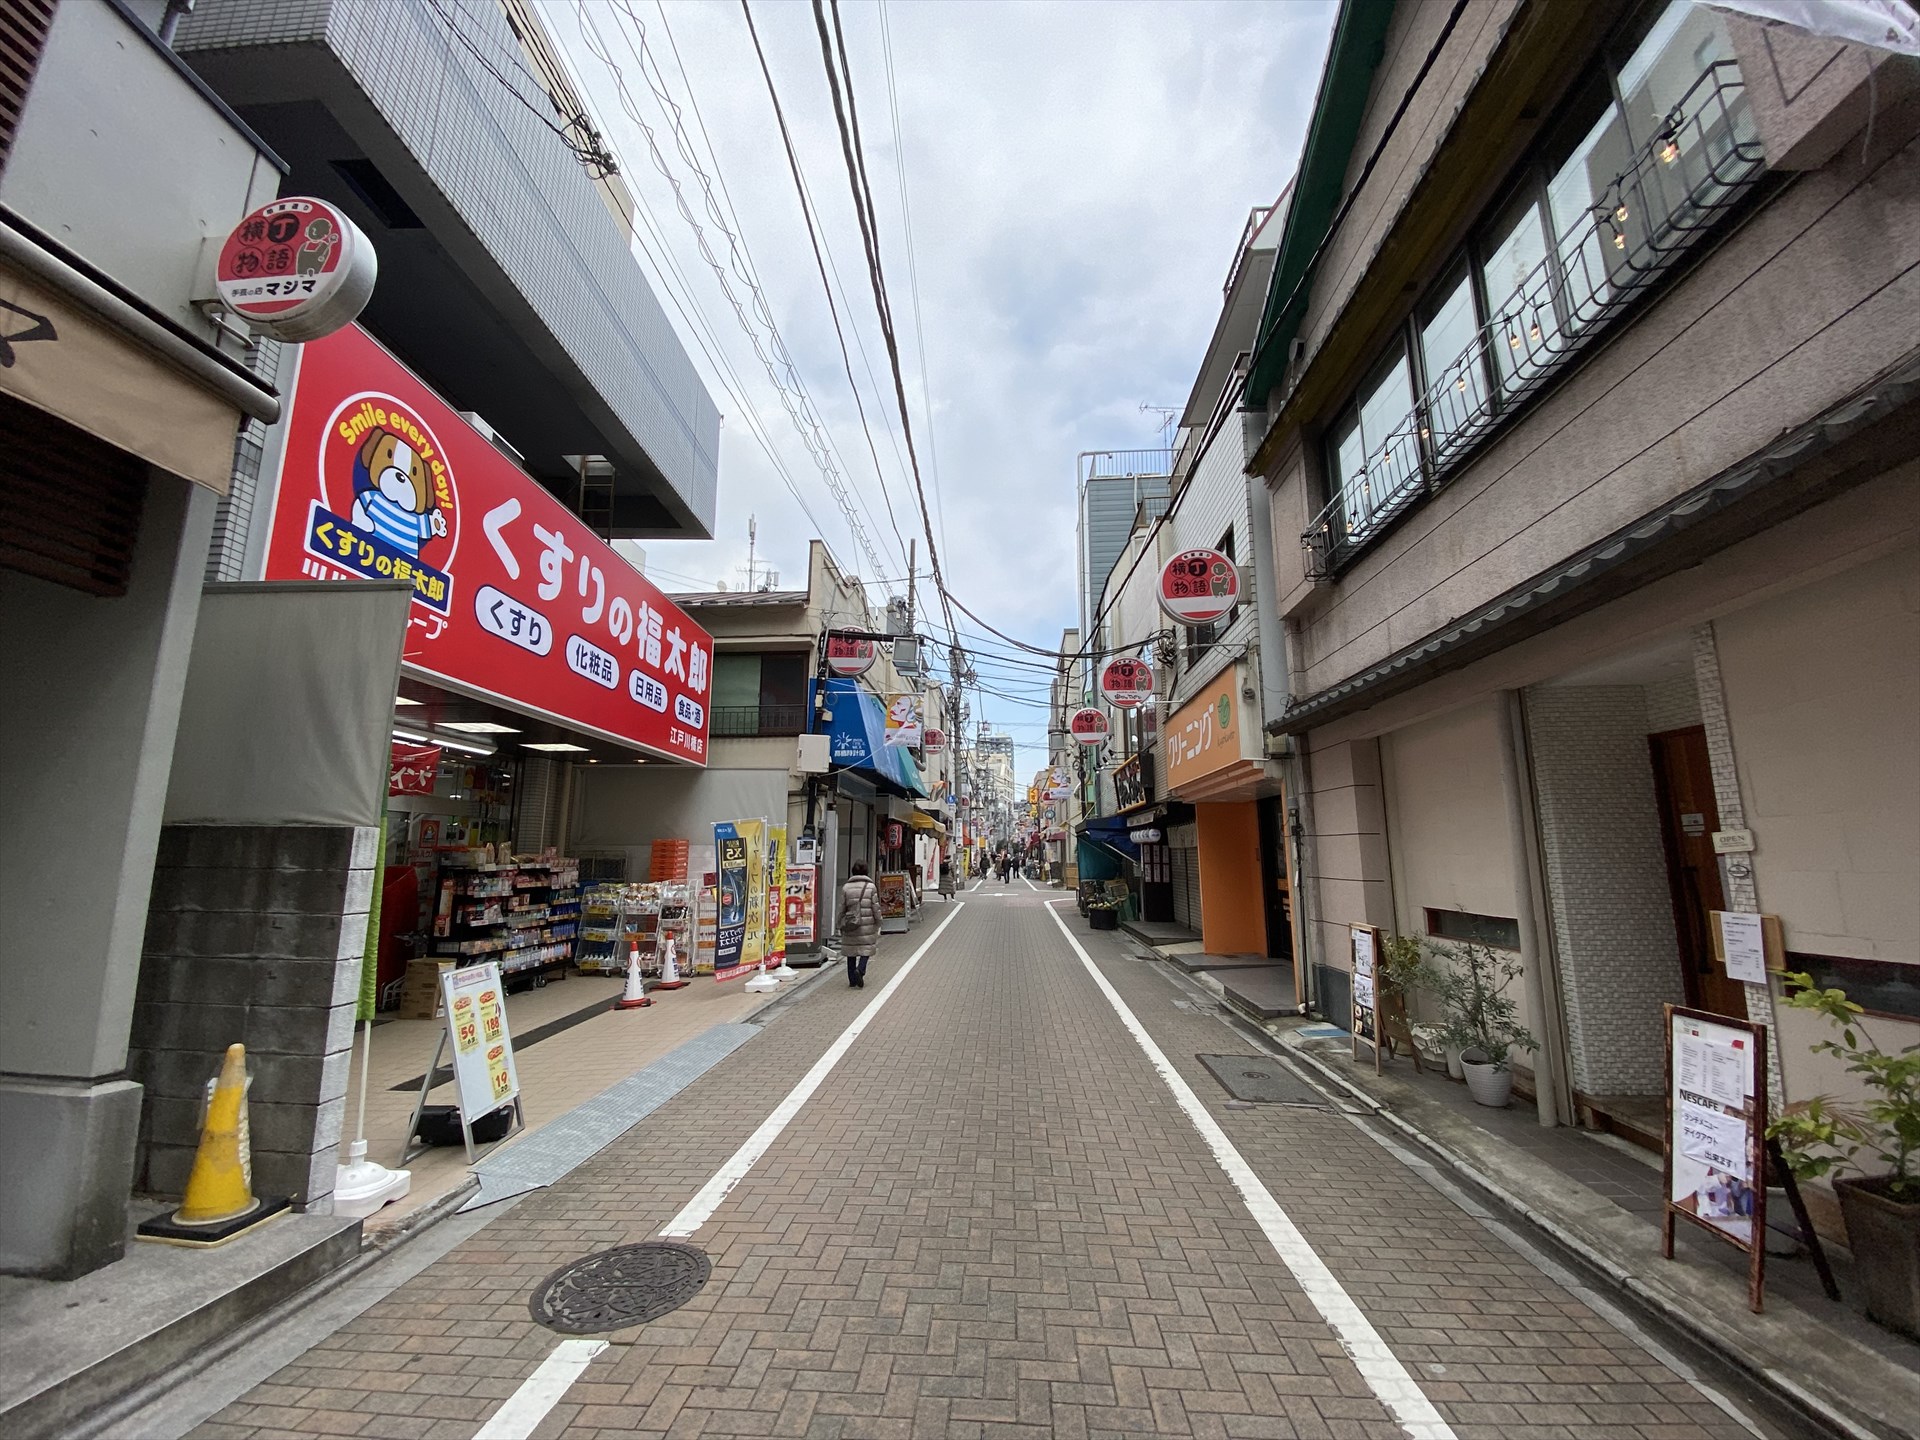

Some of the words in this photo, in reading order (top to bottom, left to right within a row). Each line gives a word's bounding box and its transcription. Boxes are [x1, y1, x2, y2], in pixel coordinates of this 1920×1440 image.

[241, 217, 295, 242] 横丁
[235, 249, 290, 273] 物語
[339, 402, 387, 445] Smile
[390, 411, 433, 459] every
[431, 459, 454, 509] day!
[315, 520, 445, 602] くすりの福太郎
[482, 496, 708, 694] くすりの福太郎
[1174, 580, 1207, 595] 物語
[407, 614, 449, 640] ープ
[490, 599, 543, 646] くすり
[574, 642, 613, 683] 化粧品
[634, 673, 662, 708] 日用品
[669, 725, 703, 755] 江戸川橋店
[1168, 702, 1214, 769] クリーニング
[390, 763, 433, 790] イント
[1719, 835, 1746, 843] OPEN
[461, 1024, 475, 1040] 59
[486, 1016, 500, 1031] 188
[495, 1071, 507, 1088] 19
[1684, 1126, 1719, 1146] テイクアウト
